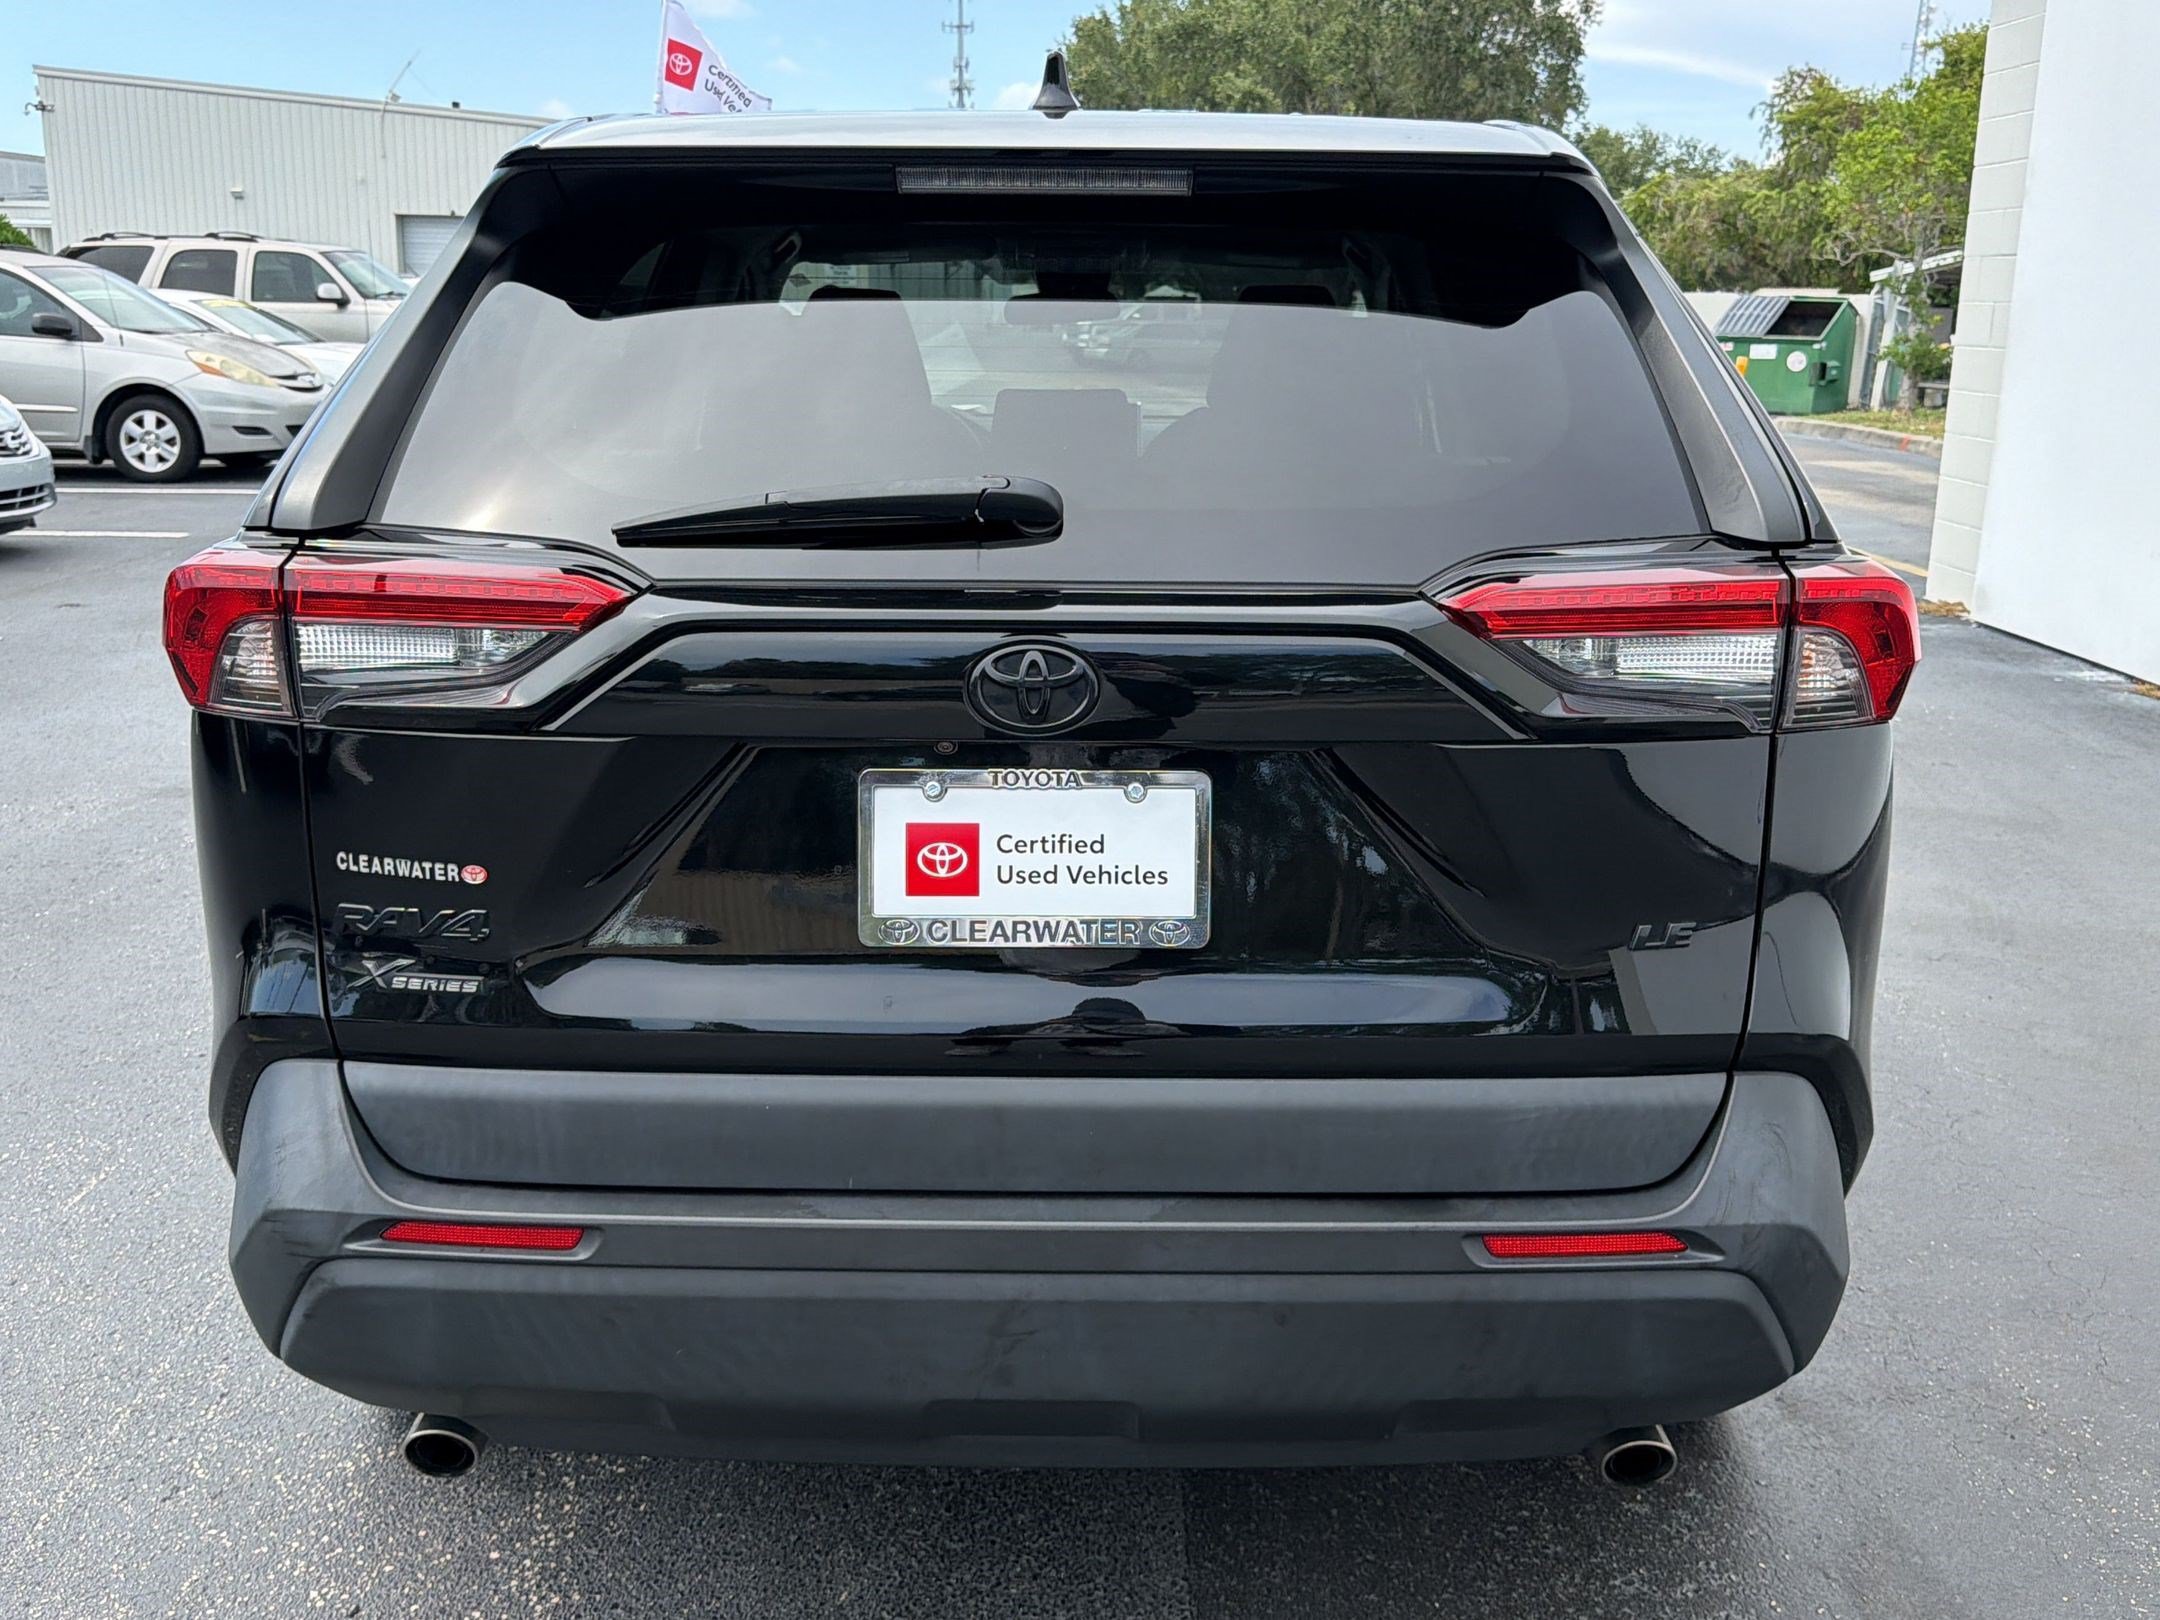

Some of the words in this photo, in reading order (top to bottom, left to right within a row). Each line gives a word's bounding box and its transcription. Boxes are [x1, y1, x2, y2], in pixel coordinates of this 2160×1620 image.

[989, 770, 1082, 788] TOYOTA
[996, 834, 1105, 854] Certified
[336, 851, 460, 882] CLEARWATER
[996, 865, 1058, 885] Used
[1066, 864, 1169, 885] Vehicles
[335, 903, 490, 941] RAV4
[926, 920, 1140, 944] CLEARWATER
[1629, 922, 1697, 950] LE
